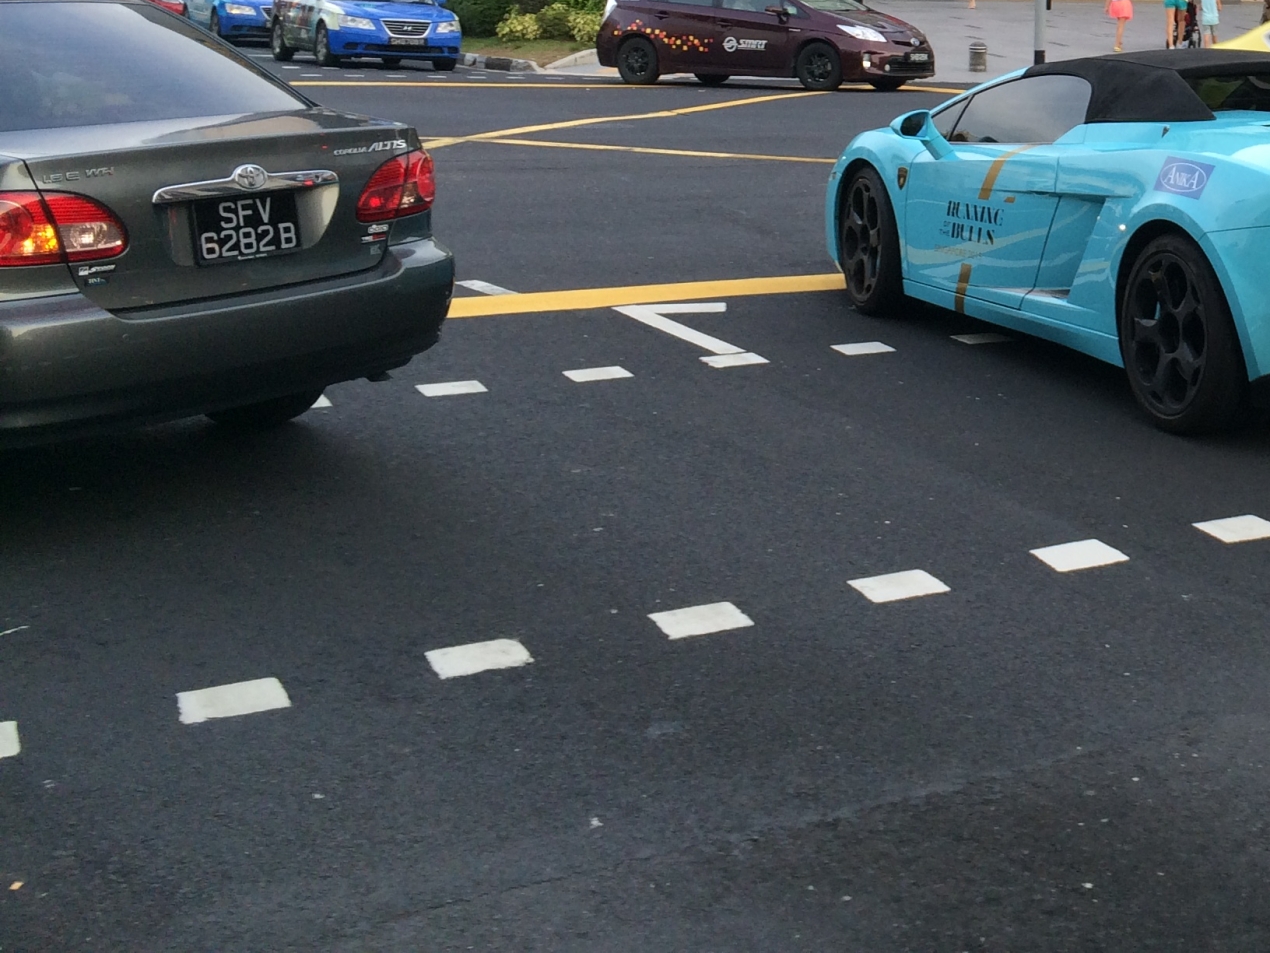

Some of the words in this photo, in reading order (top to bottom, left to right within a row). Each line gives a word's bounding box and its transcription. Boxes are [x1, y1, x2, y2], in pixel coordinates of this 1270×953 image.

[737, 40, 768, 49] SMRT
[368, 139, 407, 152] ALTIS
[218, 197, 271, 228] SFV
[946, 200, 1005, 227] RUNNING
[951, 222, 995, 246] BULLS
